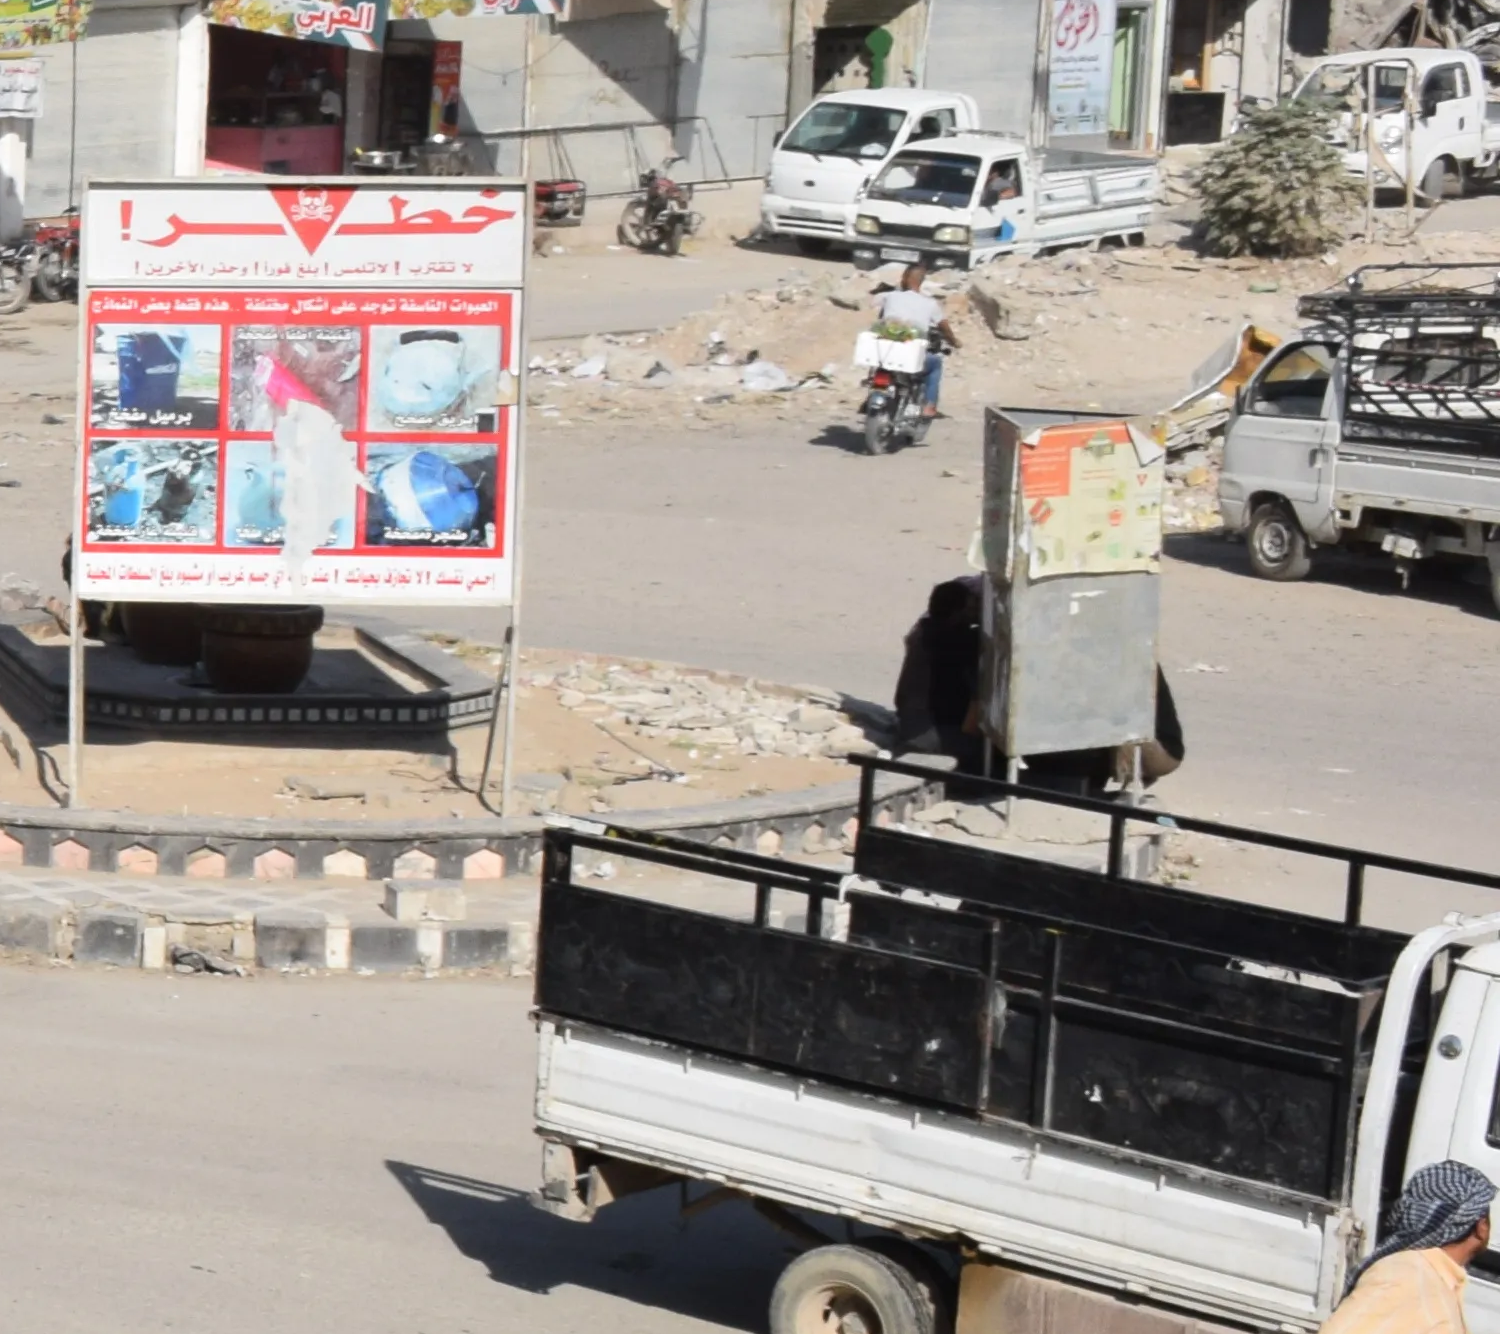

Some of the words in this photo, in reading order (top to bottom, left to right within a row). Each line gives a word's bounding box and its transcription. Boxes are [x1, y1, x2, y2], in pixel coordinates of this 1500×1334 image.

[296, 3, 376, 37] العربي
[296, 263, 320, 278] بلغ
[408, 261, 456, 276] تقترب
[462, 263, 474, 274] لا
[173, 297, 202, 312] فقط
[244, 297, 290, 313] مختلفة
[360, 298, 396, 315] توجد
[399, 297, 447, 313] الناسفة
[449, 297, 499, 315] العبوات
[108, 407, 148, 425] مفخخ
[148, 409, 193, 425] برميل
